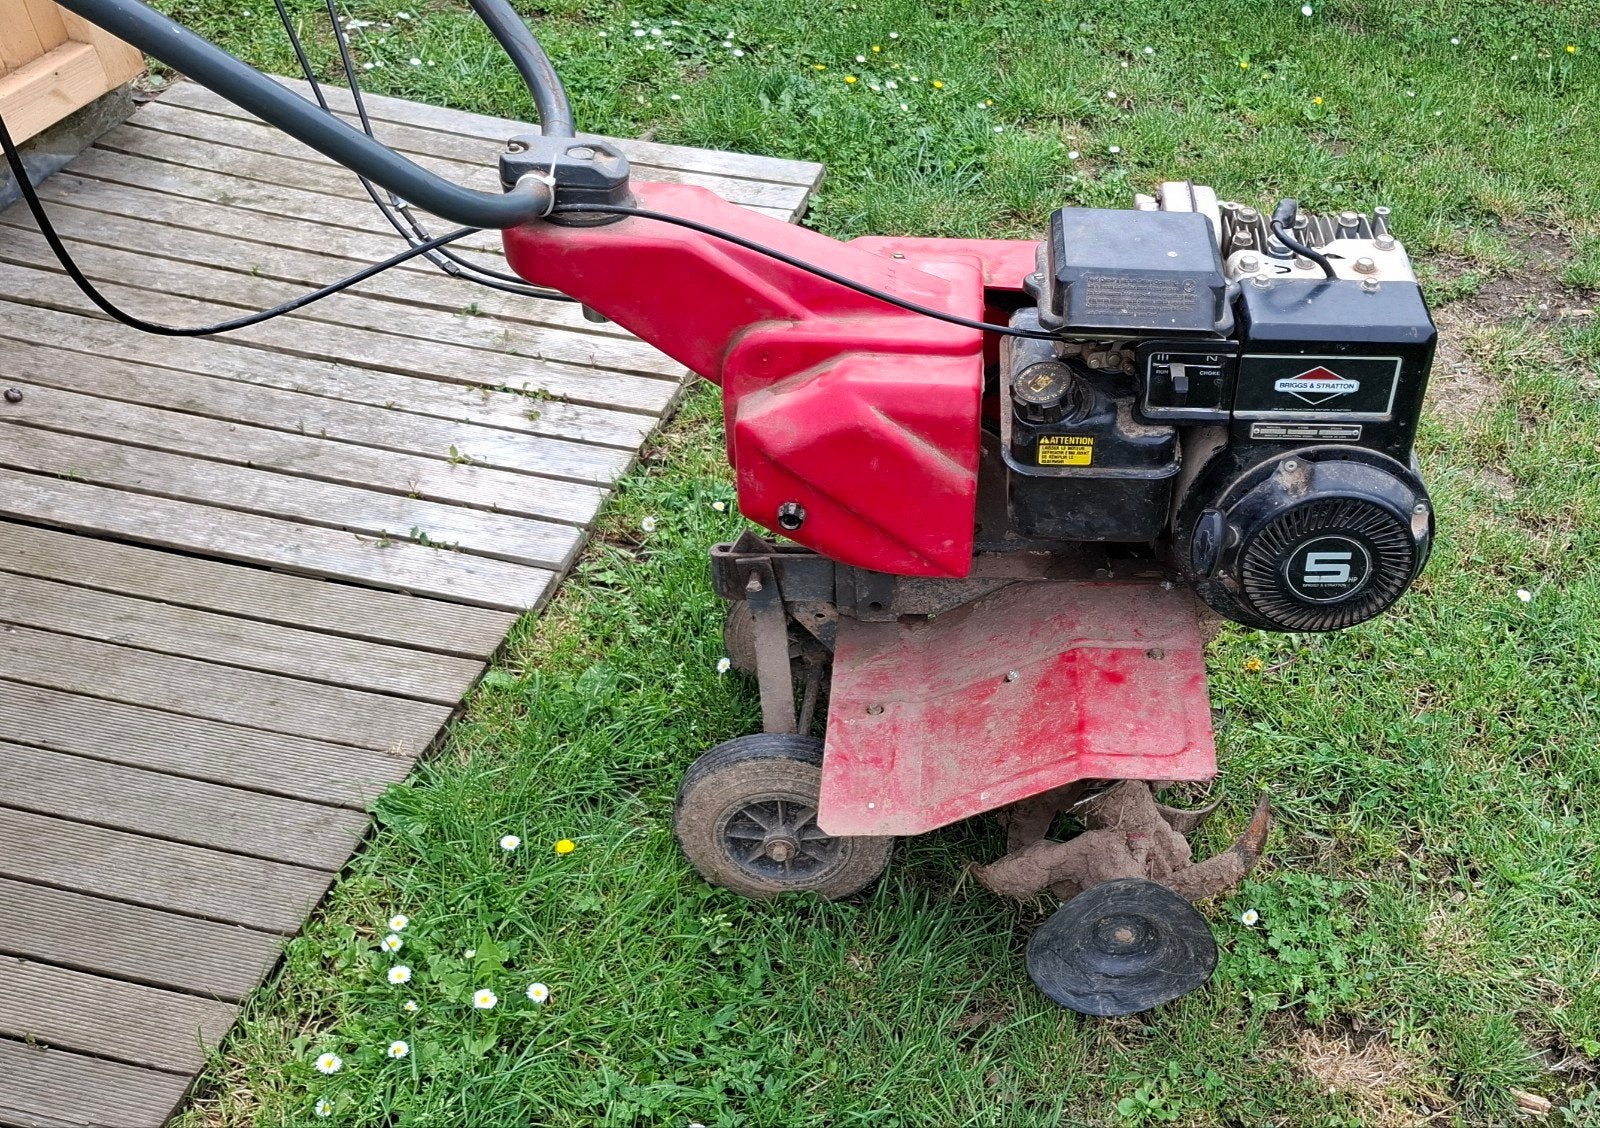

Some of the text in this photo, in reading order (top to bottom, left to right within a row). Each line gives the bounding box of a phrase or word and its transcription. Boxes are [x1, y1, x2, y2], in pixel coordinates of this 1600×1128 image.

[1316, 382, 1355, 390] STRATTON
[1050, 436, 1094, 445] ATTENTION
[1303, 552, 1352, 583] 5
